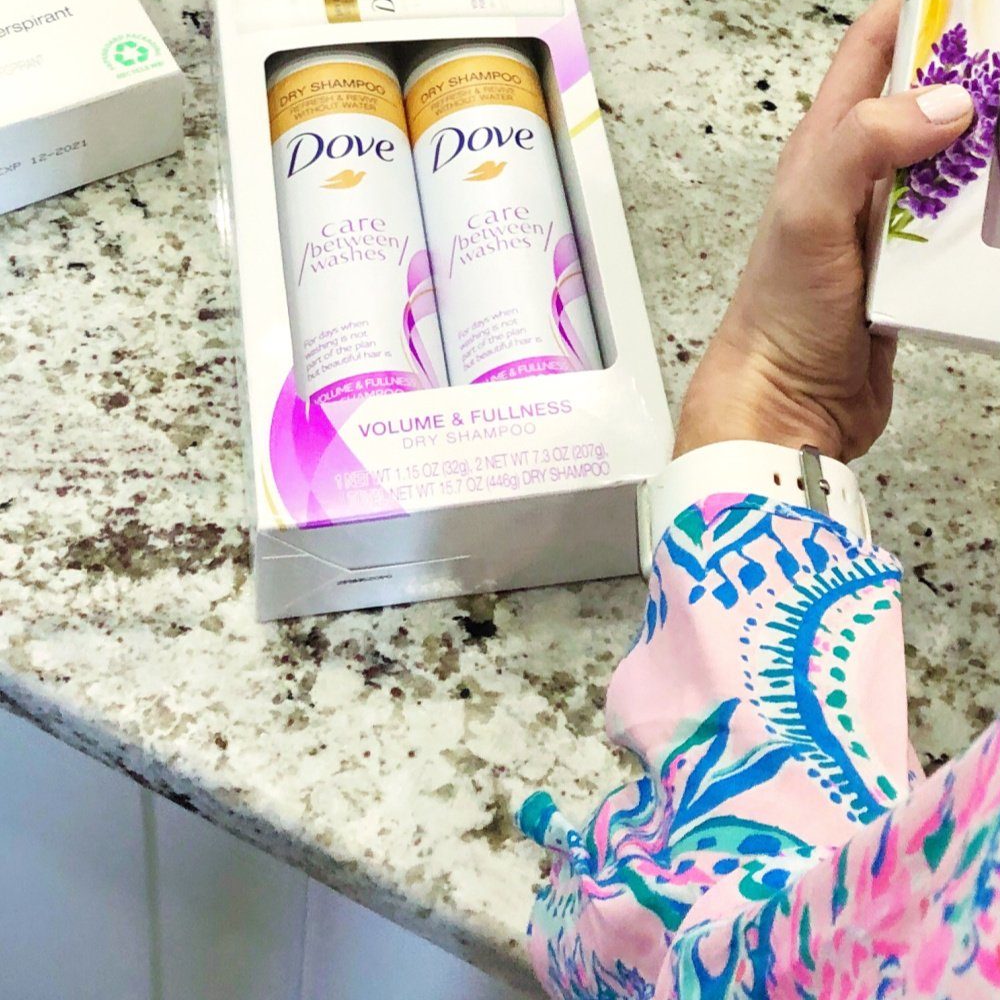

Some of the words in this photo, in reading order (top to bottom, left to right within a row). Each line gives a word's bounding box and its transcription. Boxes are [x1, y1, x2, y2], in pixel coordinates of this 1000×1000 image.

[280, 86, 306, 107] DRY
[311, 79, 386, 96] SHAMPOO
[421, 82, 446, 104] DRY
[448, 71, 523, 88] SHAMPOO
[31, 139, 87, 165] 12-2021
[286, 132, 395, 179] Dove
[430, 126, 534, 174] Dove
[321, 217, 387, 239] care
[467, 205, 530, 230] care
[309, 235, 400, 259] between
[457, 222, 545, 251] between
[460, 236, 532, 265] washes
[310, 247, 387, 273] washes
[358, 414, 446, 438] VOLUME
[452, 412, 464, 426] &
[470, 399, 573, 424] FULLNESS
[403, 434, 438, 450] DRY
[446, 422, 536, 444] SHAMPOO
[396, 464, 420, 480] 1.15
[422, 462, 439, 478] OZ
[475, 457, 483, 471] 2
[485, 453, 508, 470] NET
[510, 451, 529, 466] WT
[552, 446, 570, 461] OZ
[390, 485, 413, 501] NET
[415, 482, 436, 498] WT
[440, 479, 462, 495] 15.7
[466, 477, 483, 492] OZ
[522, 469, 548, 486] DRY
[549, 461, 611, 482] SHAMPOO
